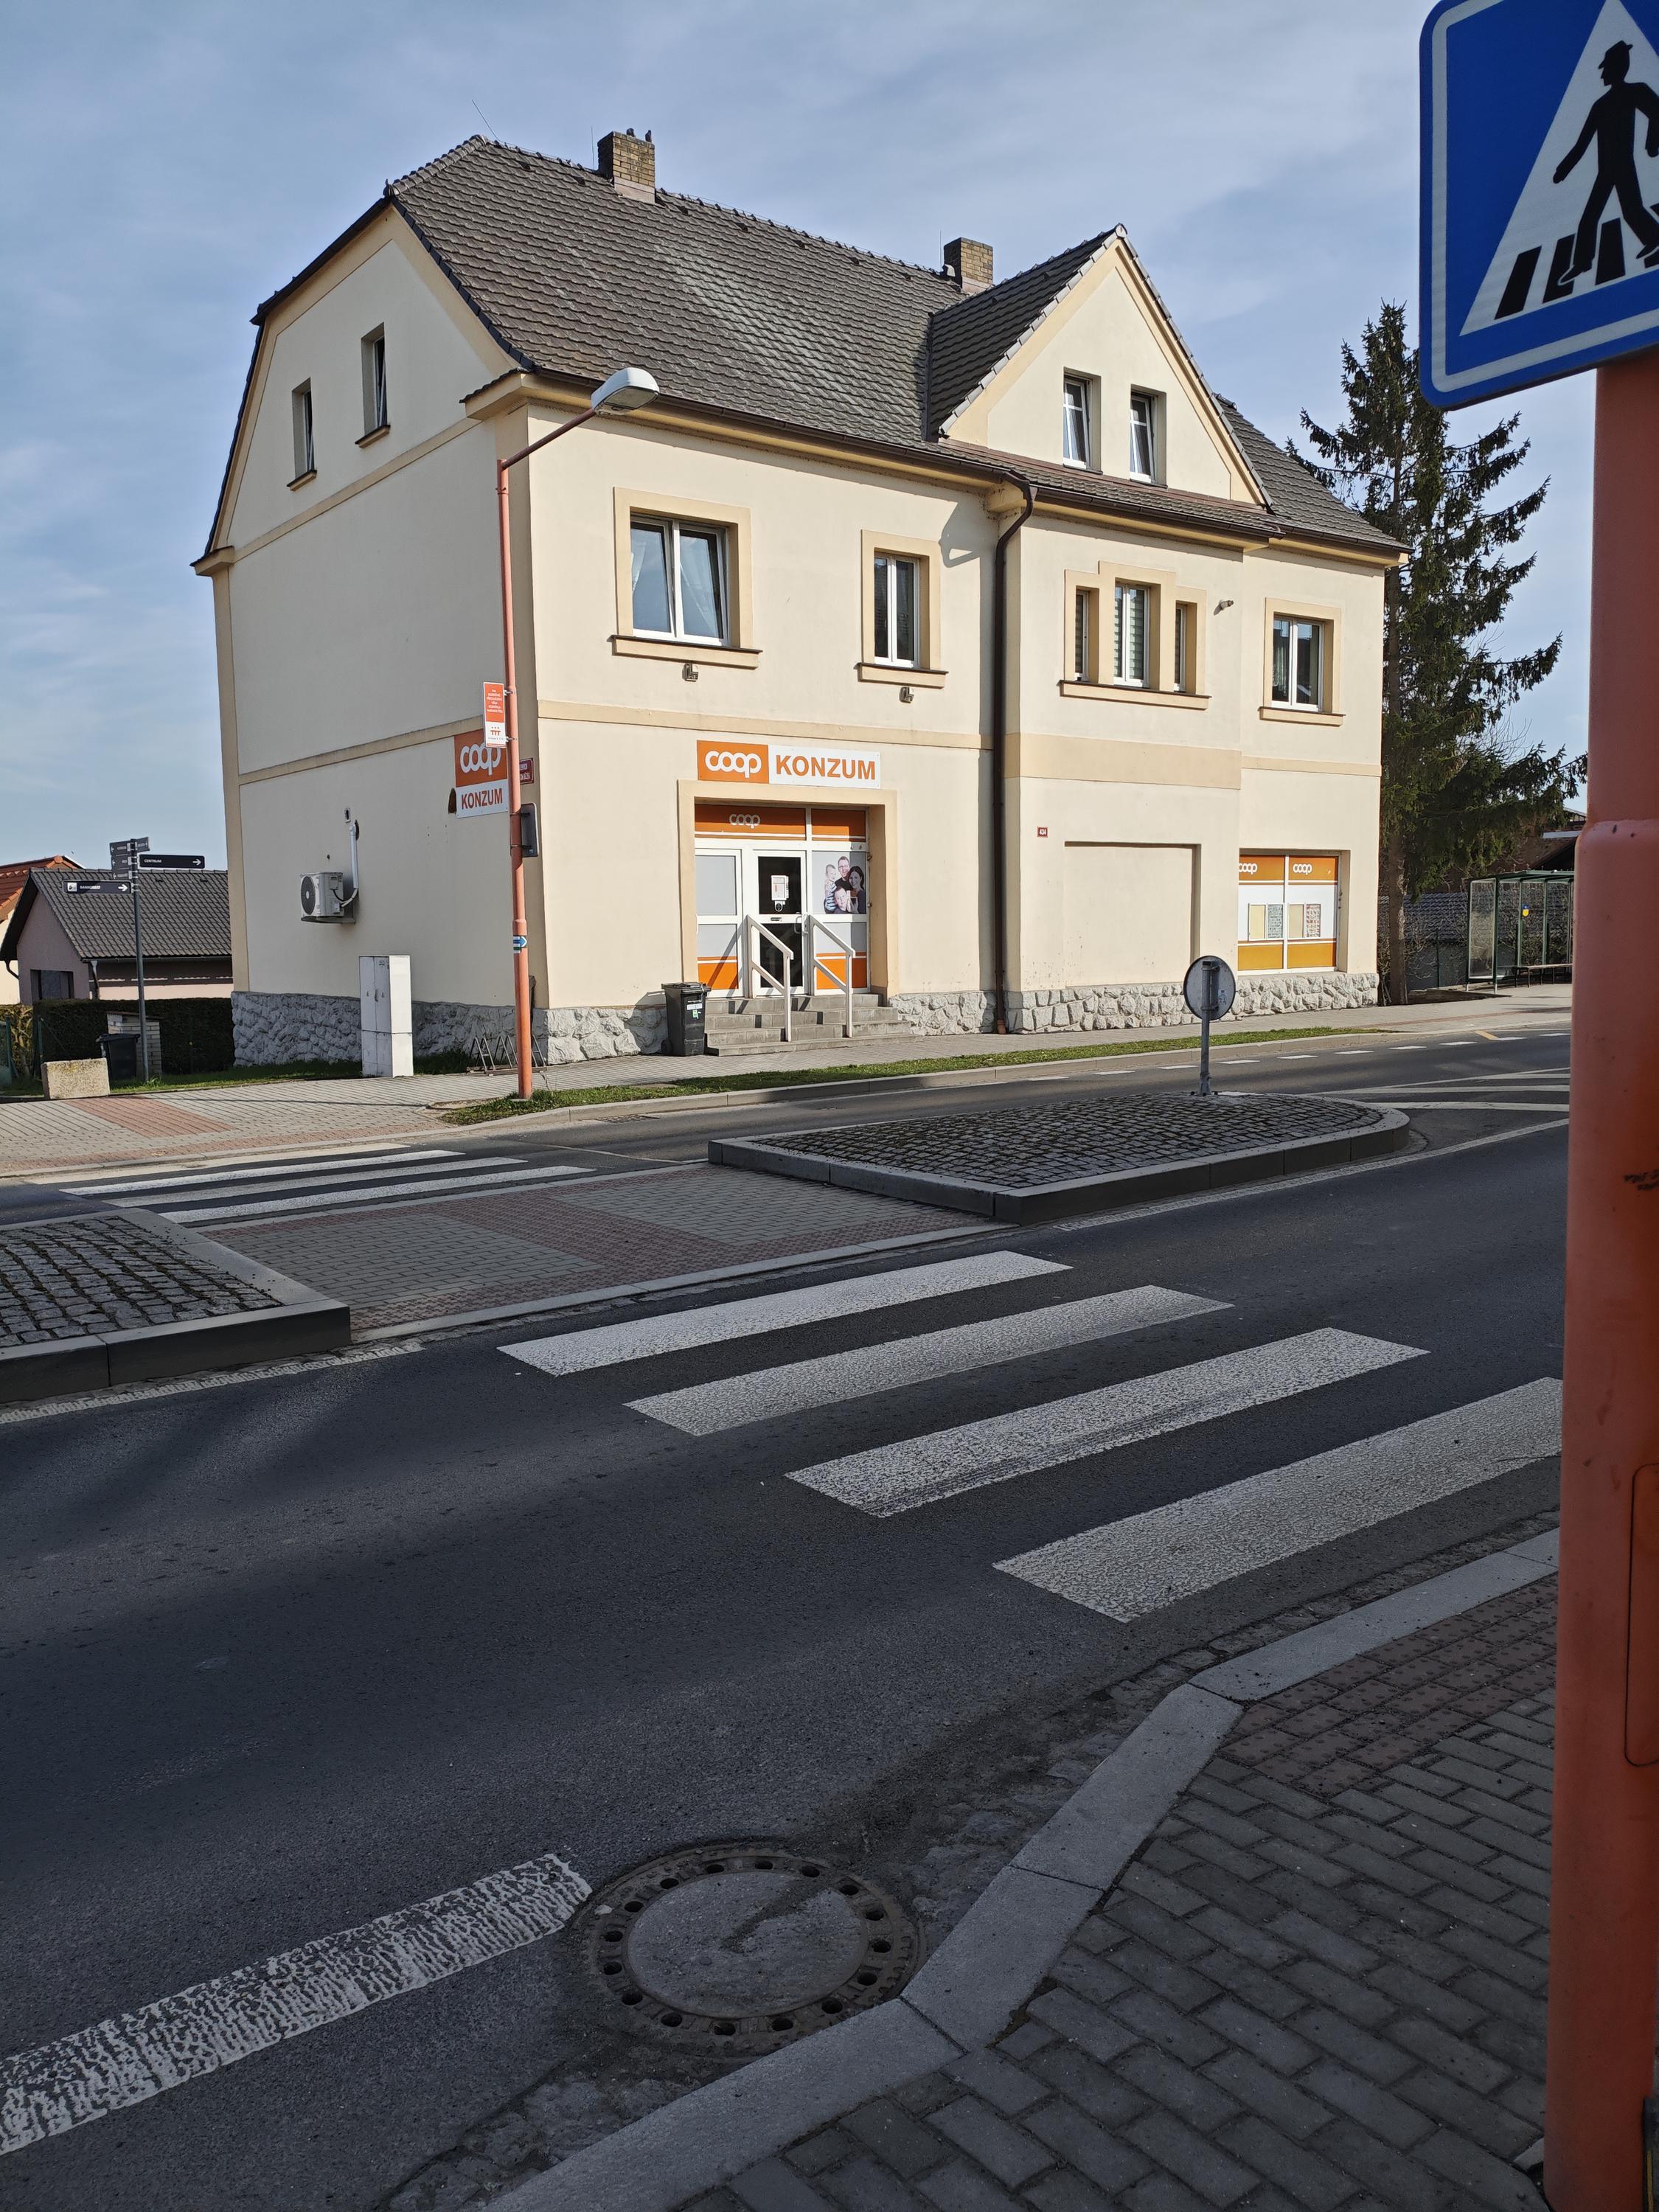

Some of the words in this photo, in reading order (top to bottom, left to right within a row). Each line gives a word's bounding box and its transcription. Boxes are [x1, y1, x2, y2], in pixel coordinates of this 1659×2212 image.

[460, 742, 501, 776] coop
[705, 751, 762, 778] coop
[776, 754, 875, 779] KONZUM
[461, 787, 503, 810] KONZUM
[729, 814, 760, 829] coop
[1238, 863, 1258, 875] coop
[1293, 863, 1312, 875] coop
